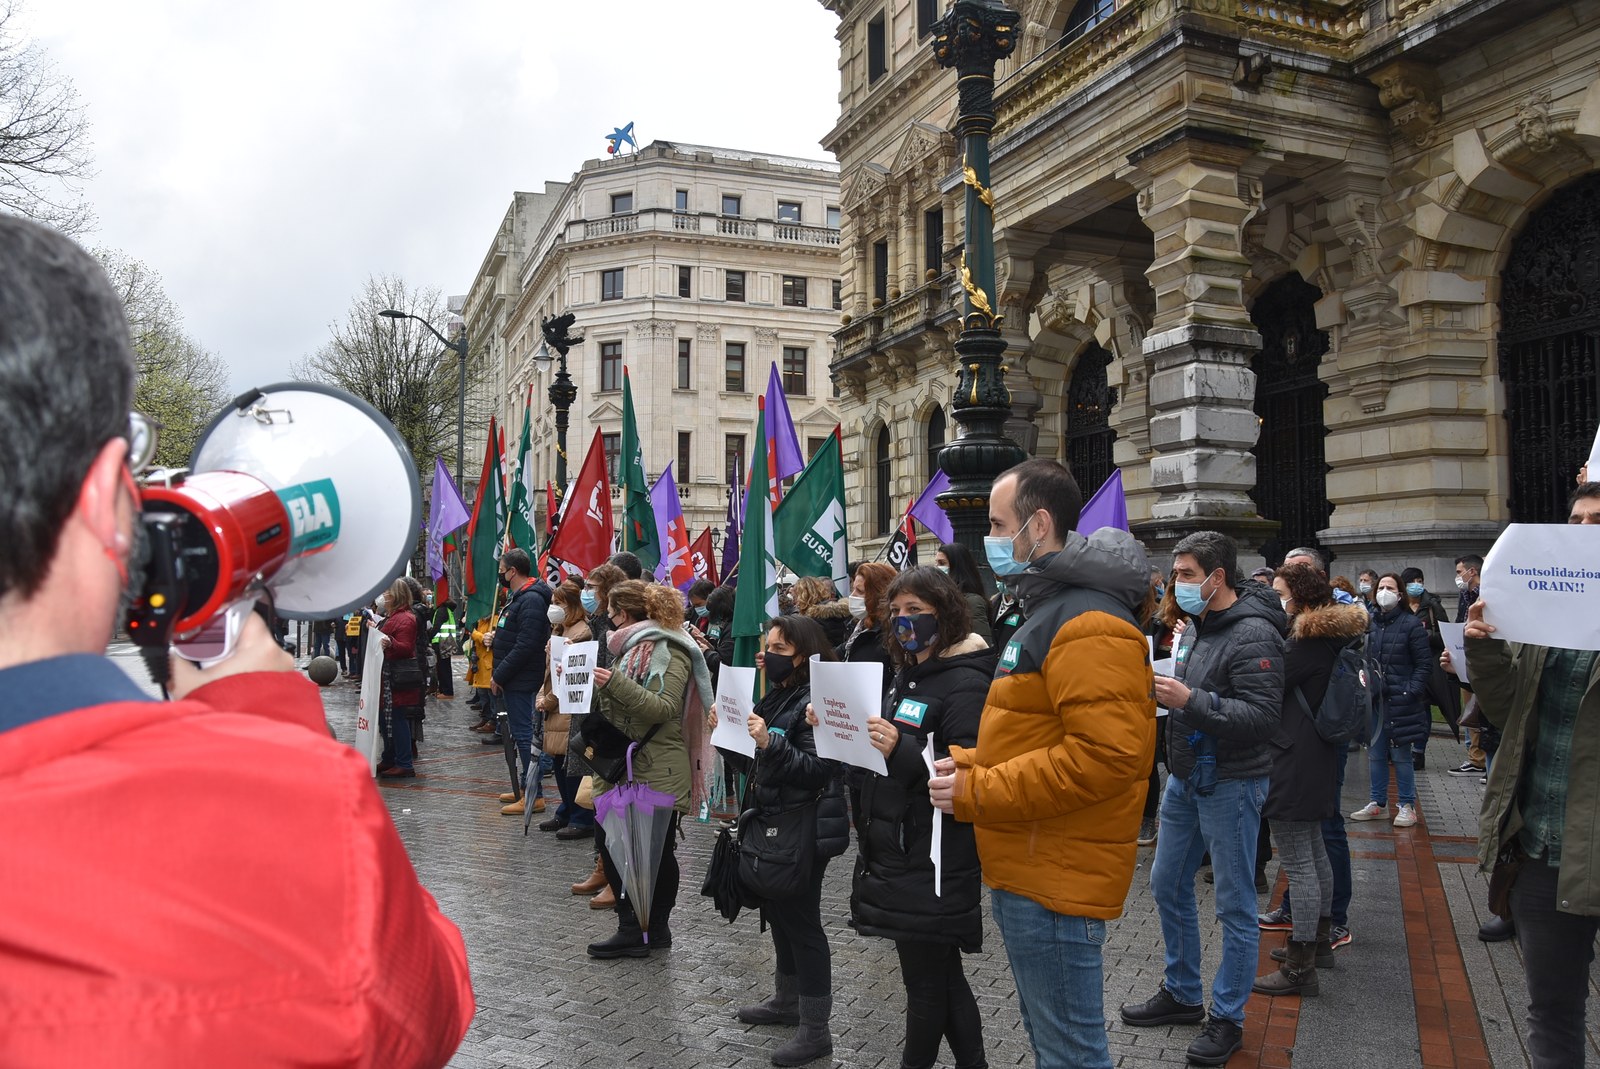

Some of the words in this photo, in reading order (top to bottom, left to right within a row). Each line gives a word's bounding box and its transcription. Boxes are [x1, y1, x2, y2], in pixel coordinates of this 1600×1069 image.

[287, 493, 333, 538] ELA
[1510, 565, 1600, 579] kontsolidazioa
[1528, 580, 1585, 593] ORAIN!!
[1003, 646, 1017, 663] ELA
[823, 697, 846, 709] Enplegu
[826, 709, 850, 720] publikoa
[899, 703, 921, 718] ELA
[824, 717, 859, 732] kontsolidatu
